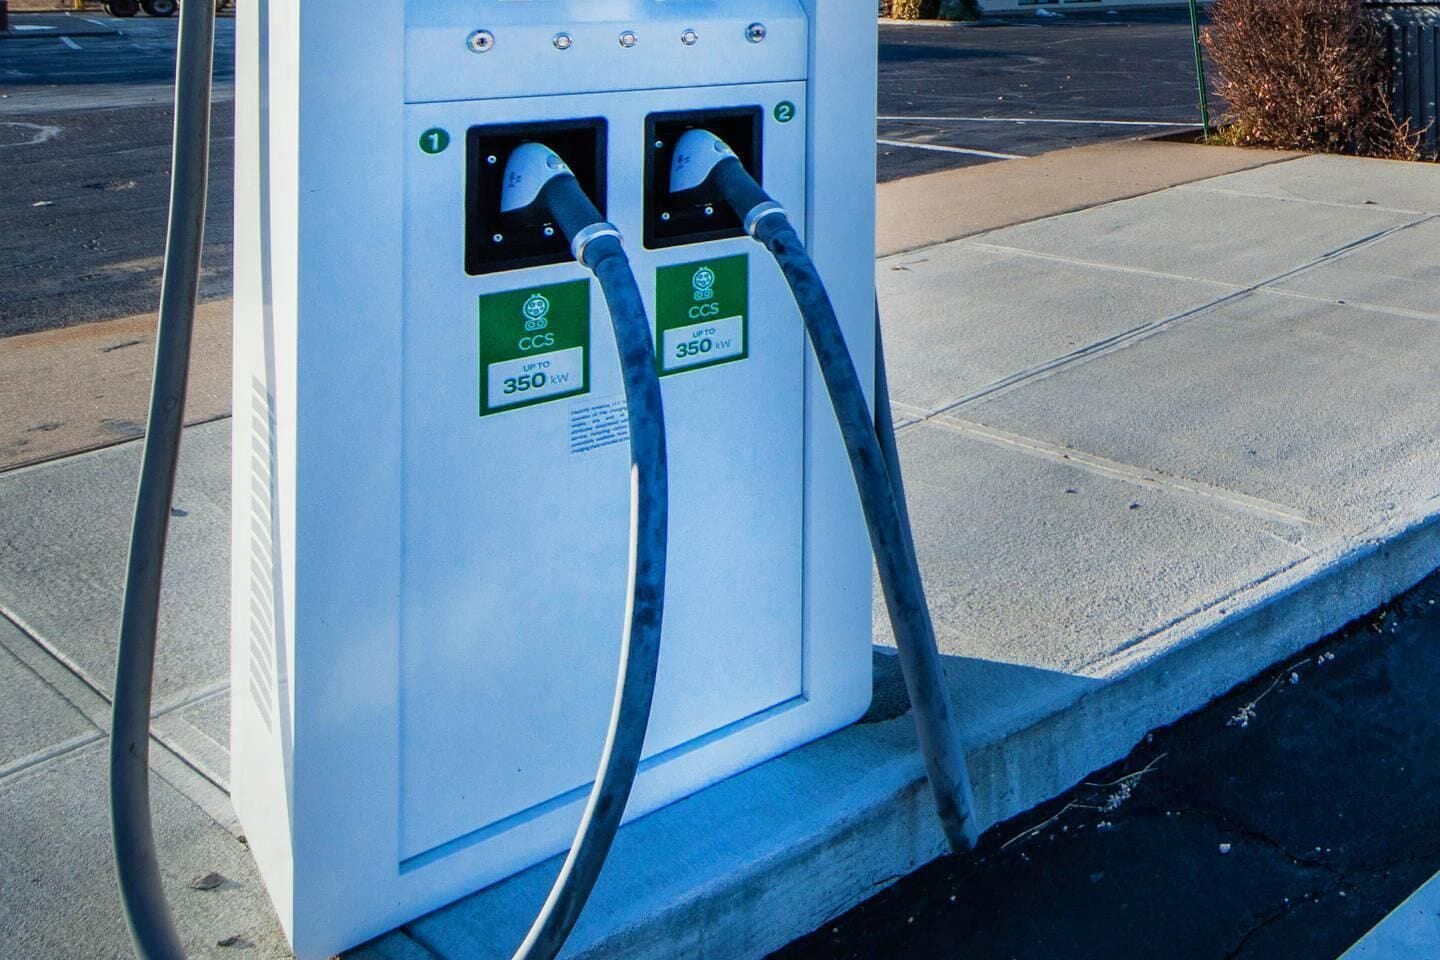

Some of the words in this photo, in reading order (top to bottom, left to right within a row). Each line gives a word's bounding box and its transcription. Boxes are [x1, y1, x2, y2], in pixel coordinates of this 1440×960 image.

[778, 104, 792, 120] 2
[428, 132, 440, 151] 1
[688, 301, 720, 319] CCS
[518, 332, 555, 351] CCS
[692, 329, 704, 338] UP
[704, 327, 716, 336] TO
[675, 338, 712, 358] 350
[715, 339, 731, 350] kW
[523, 362, 536, 373] UP
[536, 360, 551, 370] TO
[503, 372, 546, 395] 350
[550, 372, 569, 385] kW
